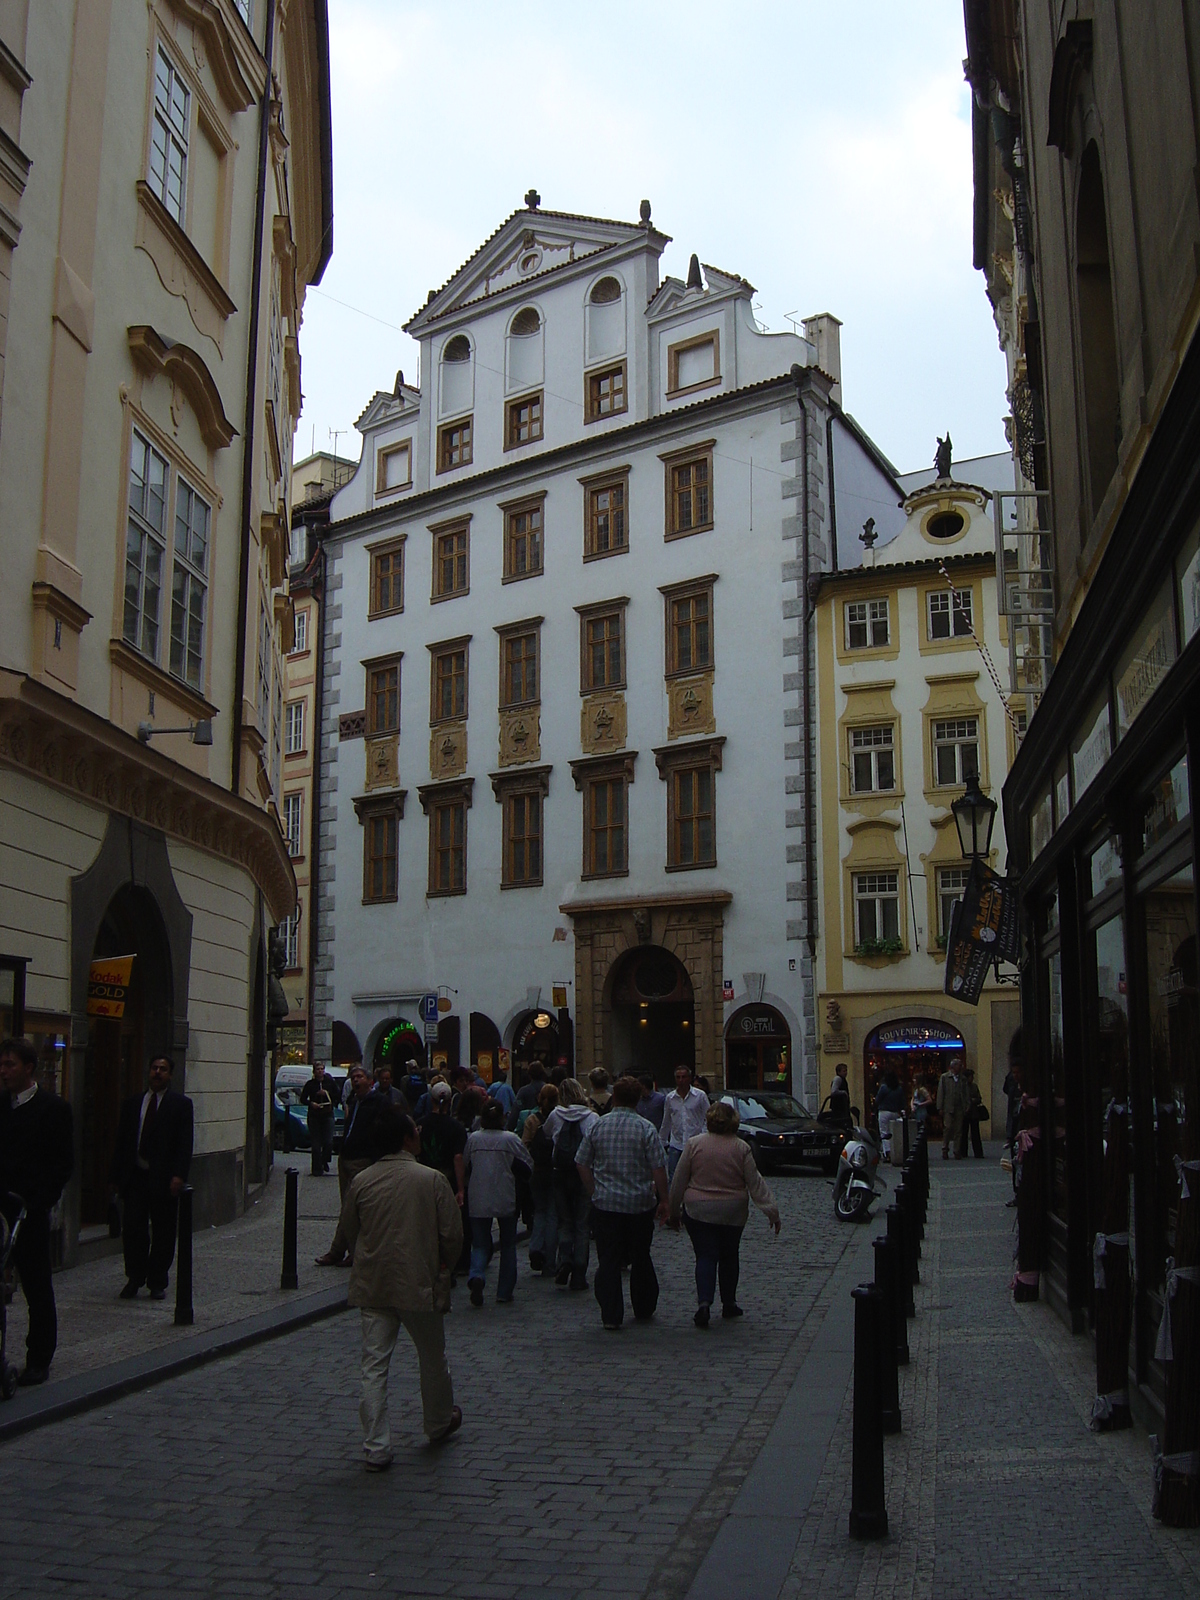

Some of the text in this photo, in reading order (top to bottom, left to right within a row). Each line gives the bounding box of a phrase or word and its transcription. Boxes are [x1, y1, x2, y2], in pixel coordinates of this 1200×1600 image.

[90, 969, 123, 984] Kodak
[88, 985, 125, 998] GOLD
[427, 998, 435, 1013] P
[879, 1027, 951, 1042] SOUVENIR'S SHOP
